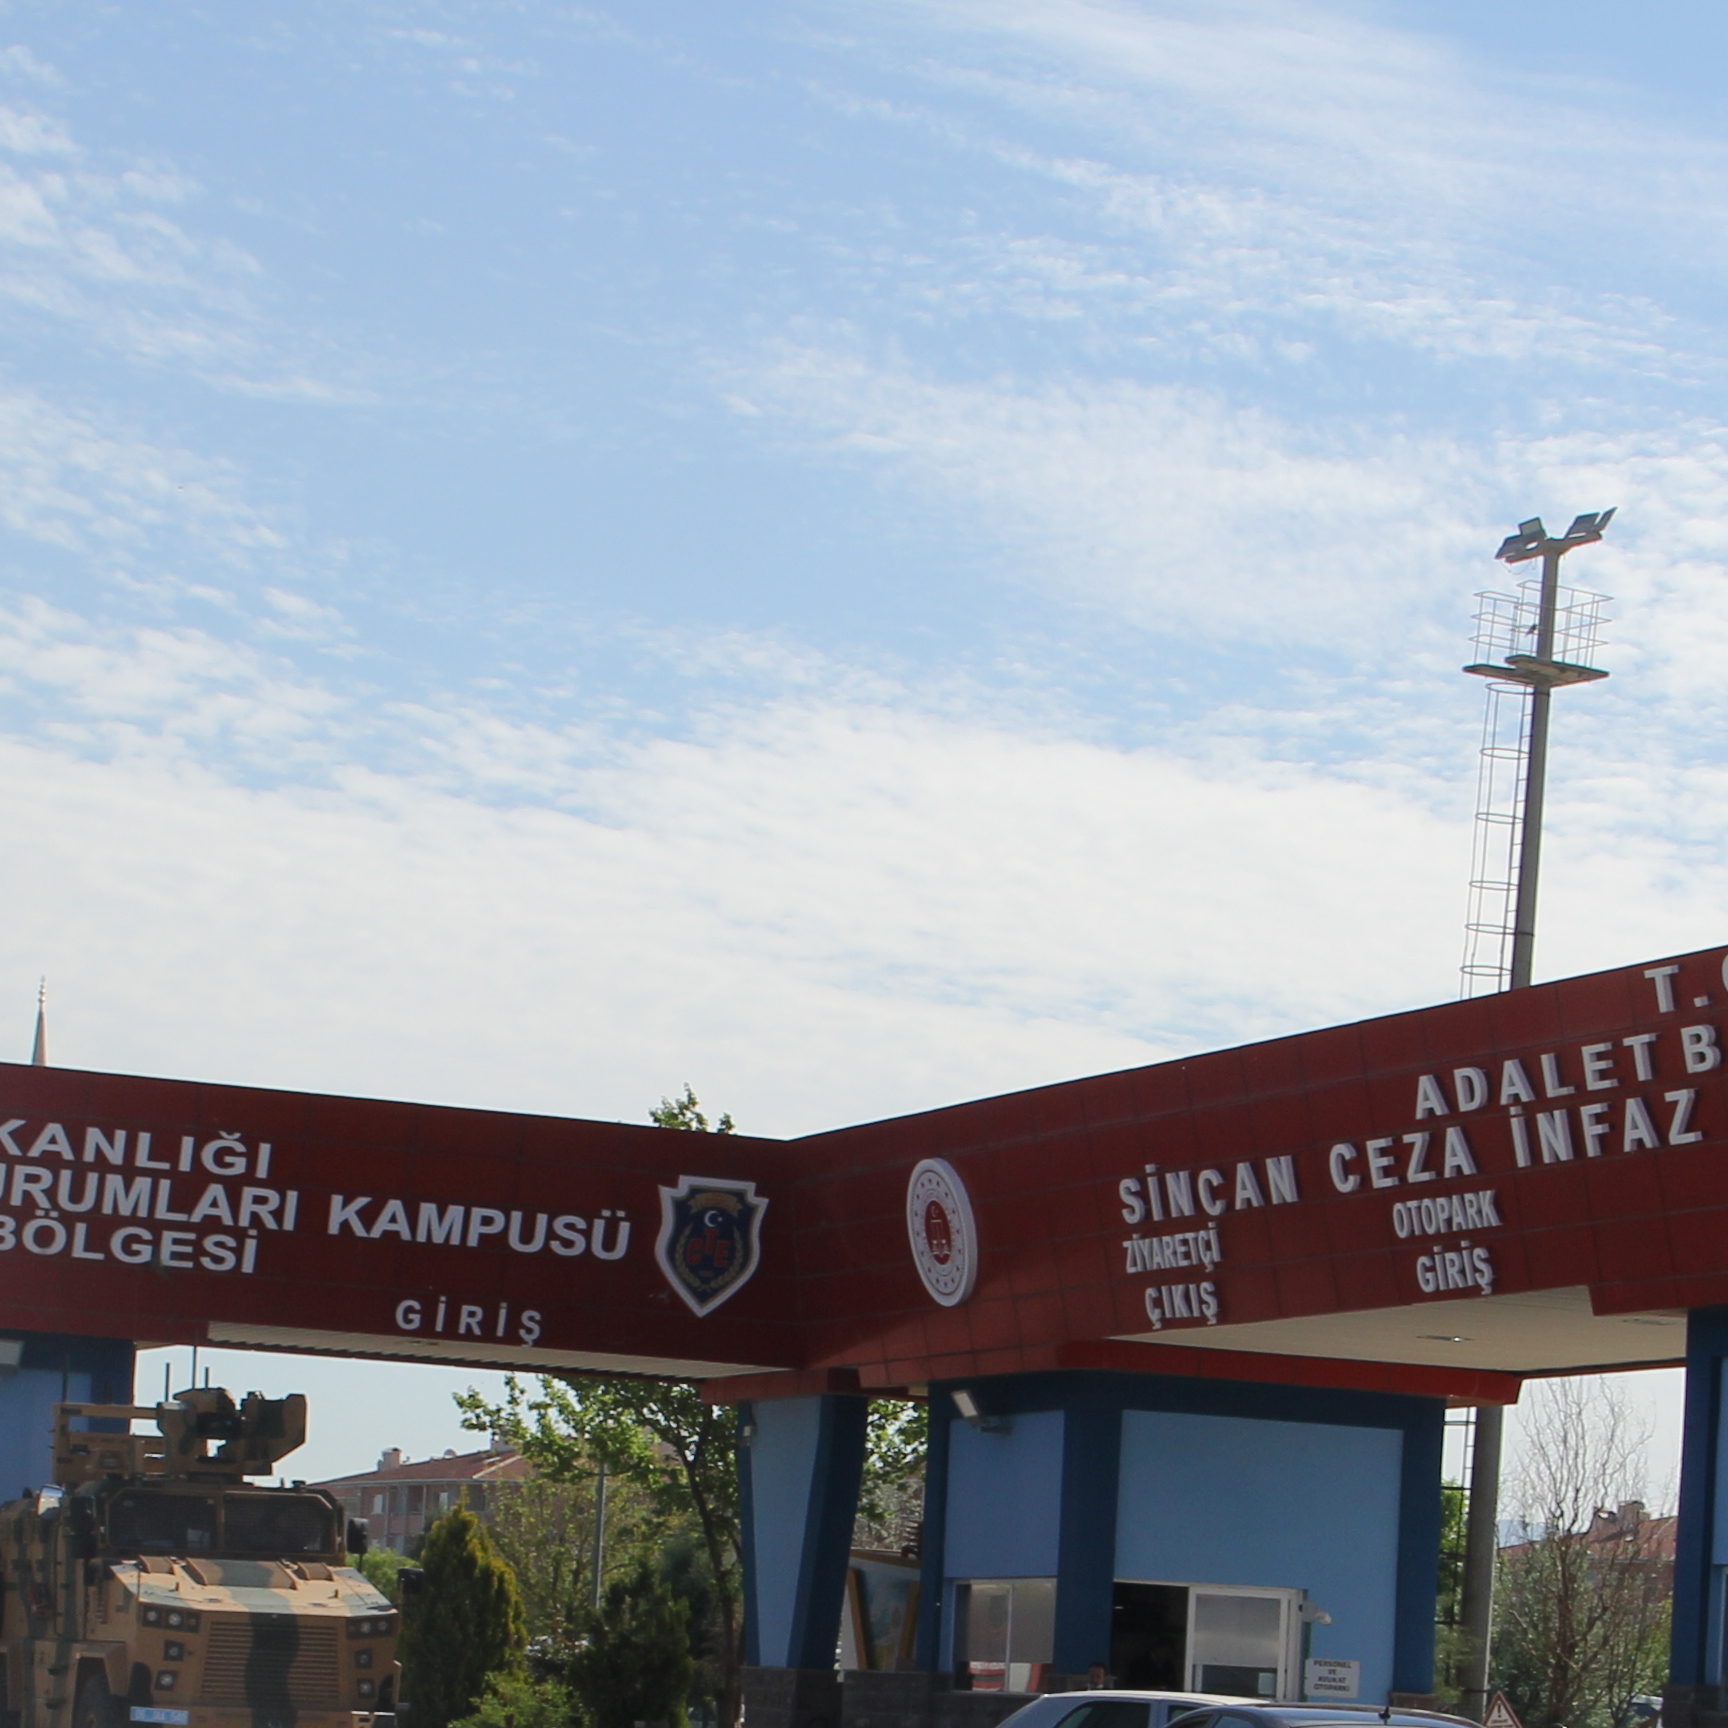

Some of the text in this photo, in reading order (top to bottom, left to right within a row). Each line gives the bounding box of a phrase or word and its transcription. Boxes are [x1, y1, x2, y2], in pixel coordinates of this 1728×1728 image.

[1415, 1032, 1658, 1120] ADALET
[1119, 1154, 1299, 1225] SİNCAN
[1329, 1126, 1478, 1194] CEZA
[1510, 1087, 1704, 1169] İNFAZ
[326, 1194, 632, 1261] KAMPUSÜ
[1392, 1189, 1501, 1241] OTOPARK
[1122, 1222, 1221, 1275] ZİYARETÇİ
[1416, 1240, 1495, 1296] GİRİŞ
[395, 1294, 543, 1347] GİRİŞ
[1144, 1281, 1219, 1330] ÇIKIŞ
